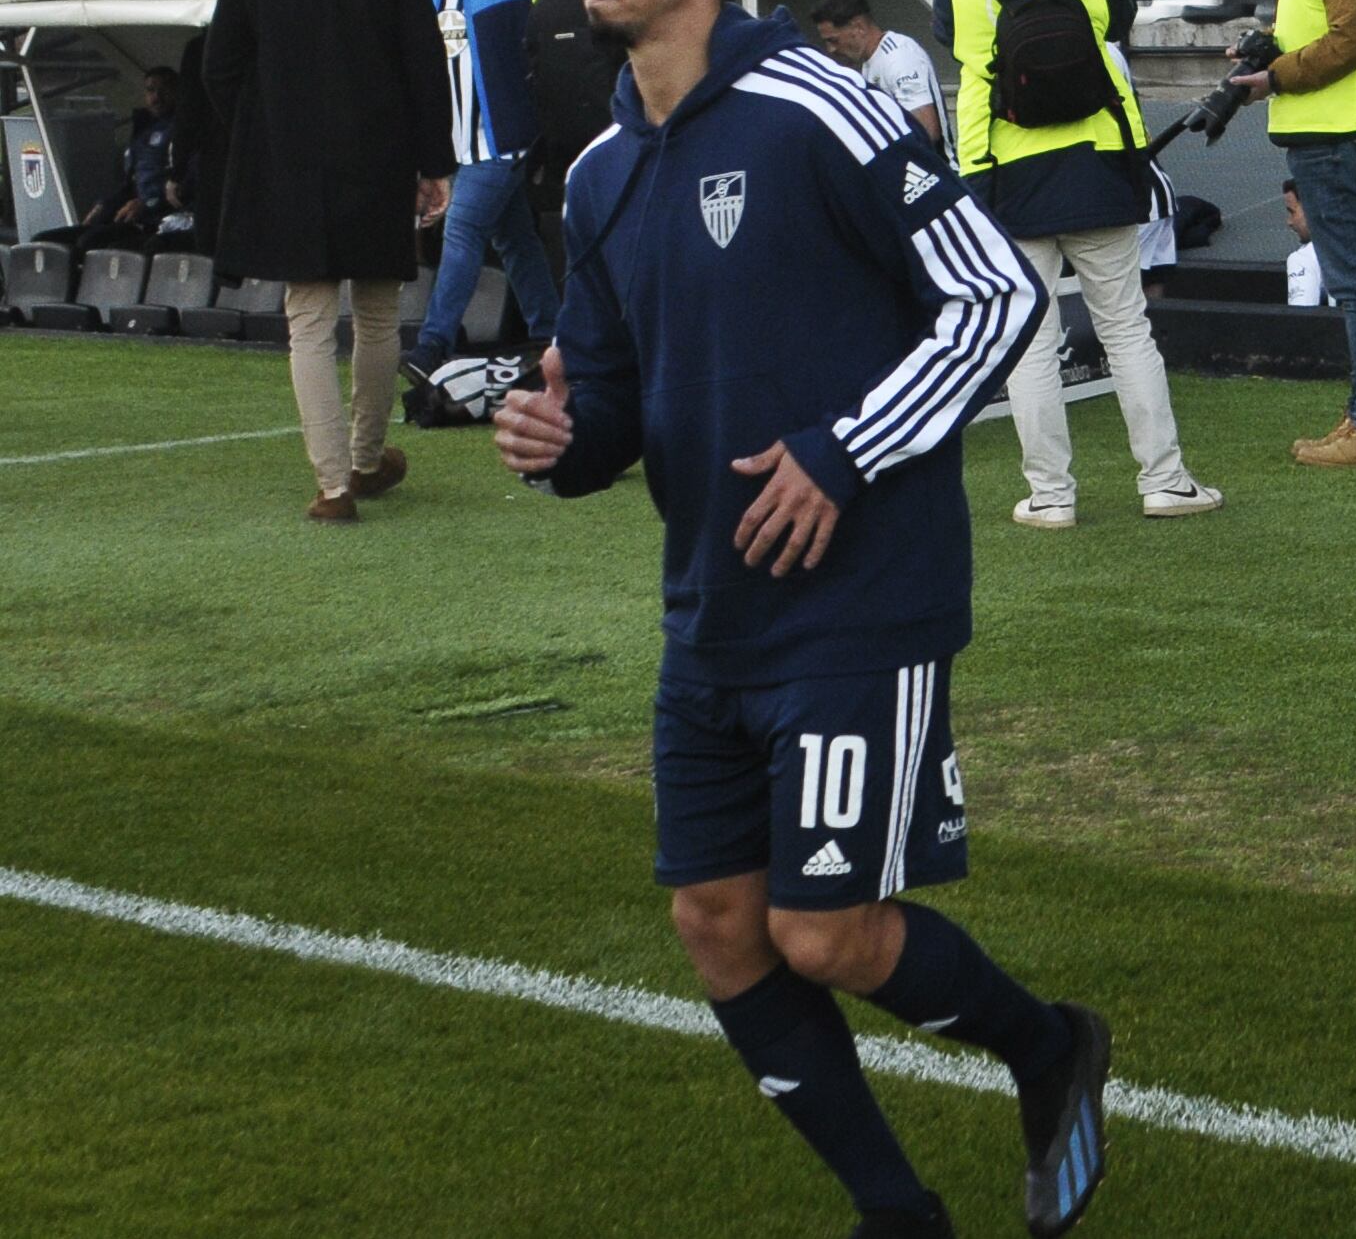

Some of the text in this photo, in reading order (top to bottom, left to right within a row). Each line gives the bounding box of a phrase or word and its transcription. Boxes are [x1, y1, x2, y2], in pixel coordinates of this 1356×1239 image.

[904, 173, 940, 205] adidas
[800, 733, 867, 829] 10
[802, 862, 852, 877] adidas
